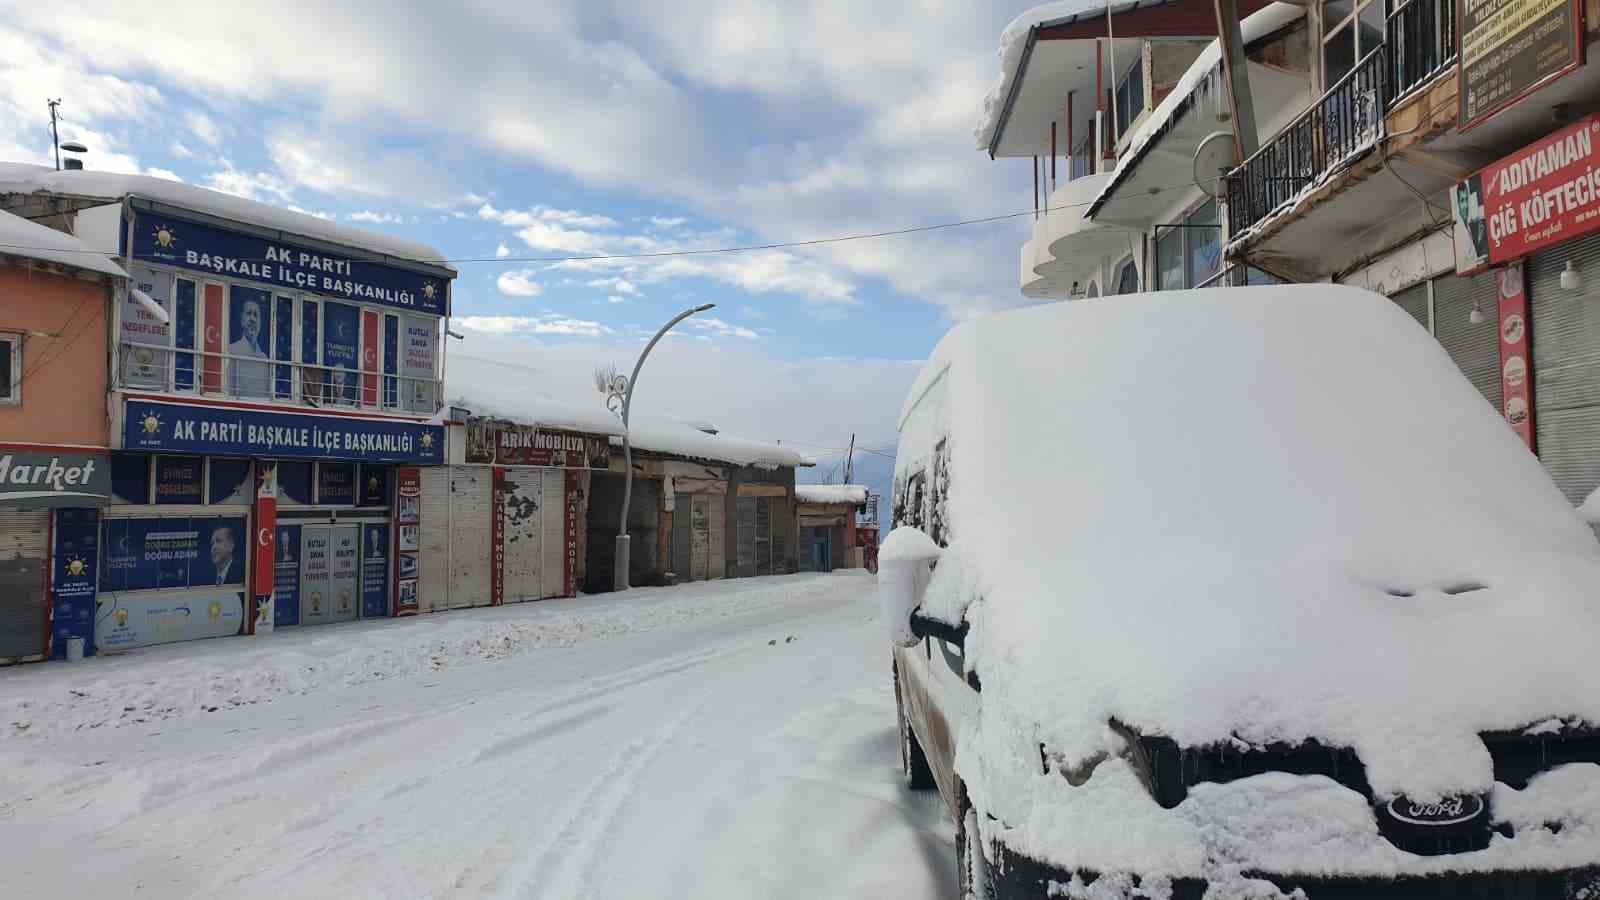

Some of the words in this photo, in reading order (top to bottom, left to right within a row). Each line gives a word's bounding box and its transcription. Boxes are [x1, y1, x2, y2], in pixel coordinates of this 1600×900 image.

[1500, 127, 1592, 196] ADIYAMAN
[1490, 201, 1517, 247] ÇİĞ
[186, 250, 272, 279] BAŞKALE
[278, 268, 317, 290] İLÇE
[323, 276, 415, 305] BAŞKANLIĞI
[265, 246, 291, 264] AK
[299, 253, 351, 276] PARTİ
[173, 420, 195, 440] AK
[200, 419, 243, 443] PARTİ
[248, 424, 308, 449] BAŞKALE
[312, 424, 340, 451] İLÇE
[345, 428, 413, 454] BAŞKANLIĞI
[501, 432, 532, 448] ARIK
[534, 432, 585, 451] MOBİLYA
[145, 552, 173, 560] DOĞRU
